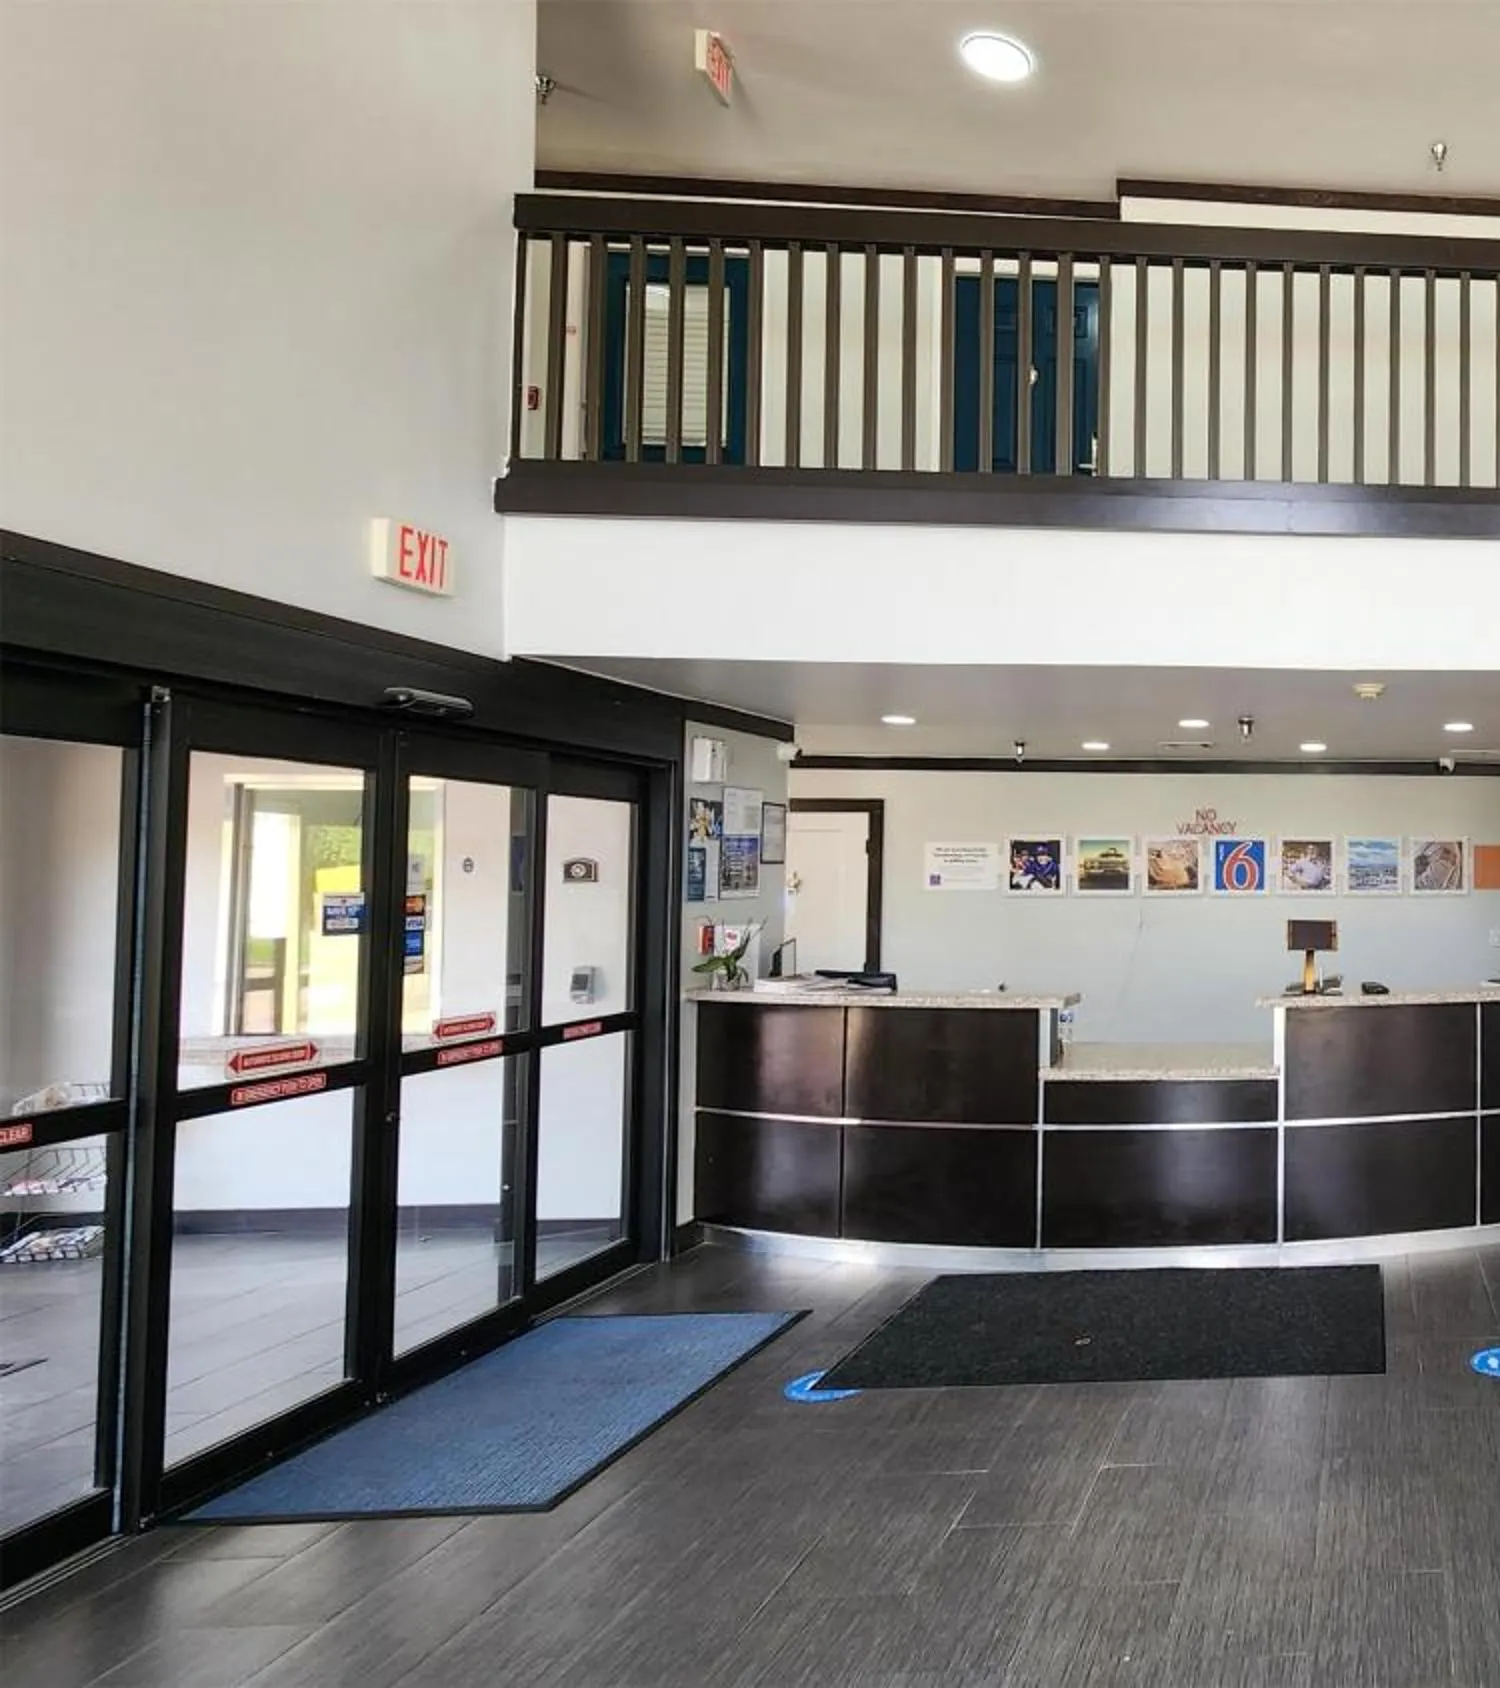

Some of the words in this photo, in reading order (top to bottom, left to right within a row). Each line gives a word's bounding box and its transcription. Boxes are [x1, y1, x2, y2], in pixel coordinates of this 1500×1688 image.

[400, 525, 449, 588] EXIT
[1176, 821, 1237, 834] VACANCY
[1195, 808, 1217, 821] NO
[1223, 841, 1260, 890] 6
